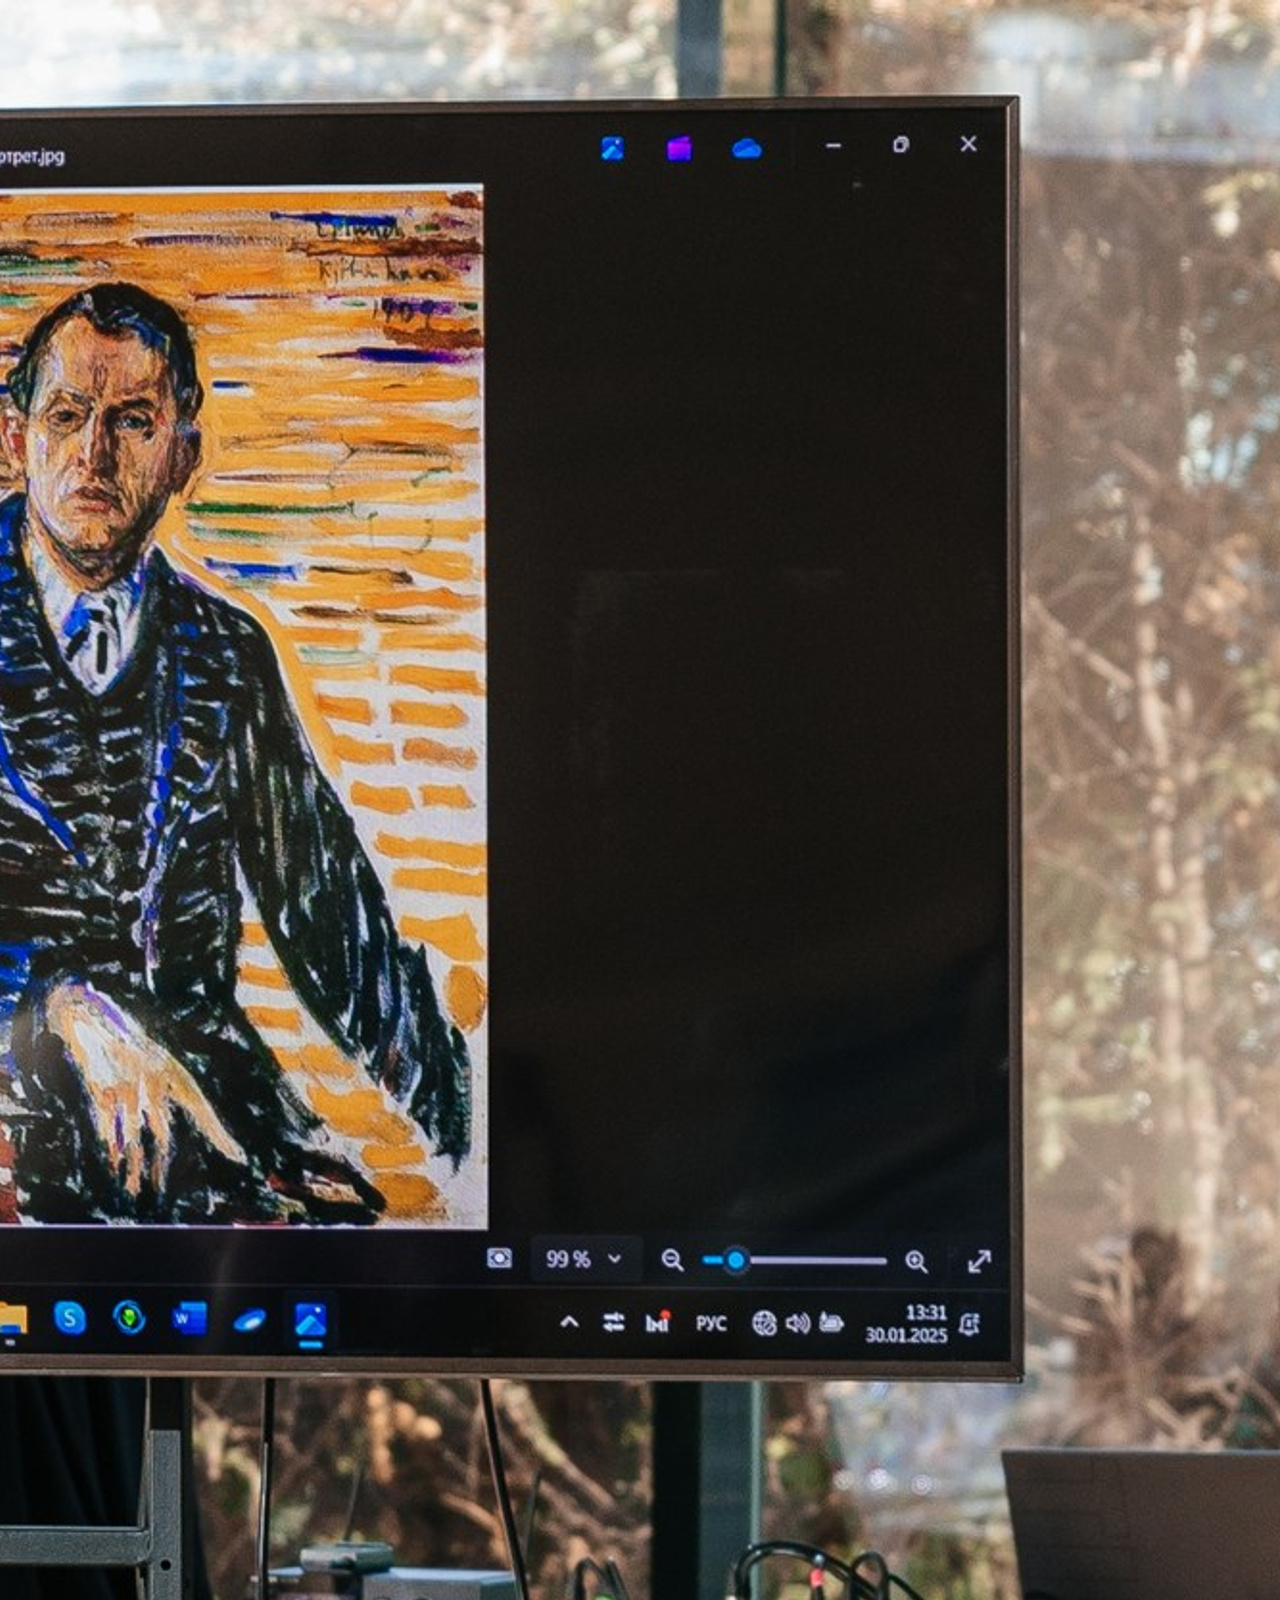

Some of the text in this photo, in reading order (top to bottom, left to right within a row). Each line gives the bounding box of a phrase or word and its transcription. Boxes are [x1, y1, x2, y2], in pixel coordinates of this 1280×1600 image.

[546, 1249, 569, 1269] 99
[906, 1304, 948, 1321] 13:31
[696, 1314, 728, 1332] РУС
[865, 1326, 949, 1344] 30.01.2025
